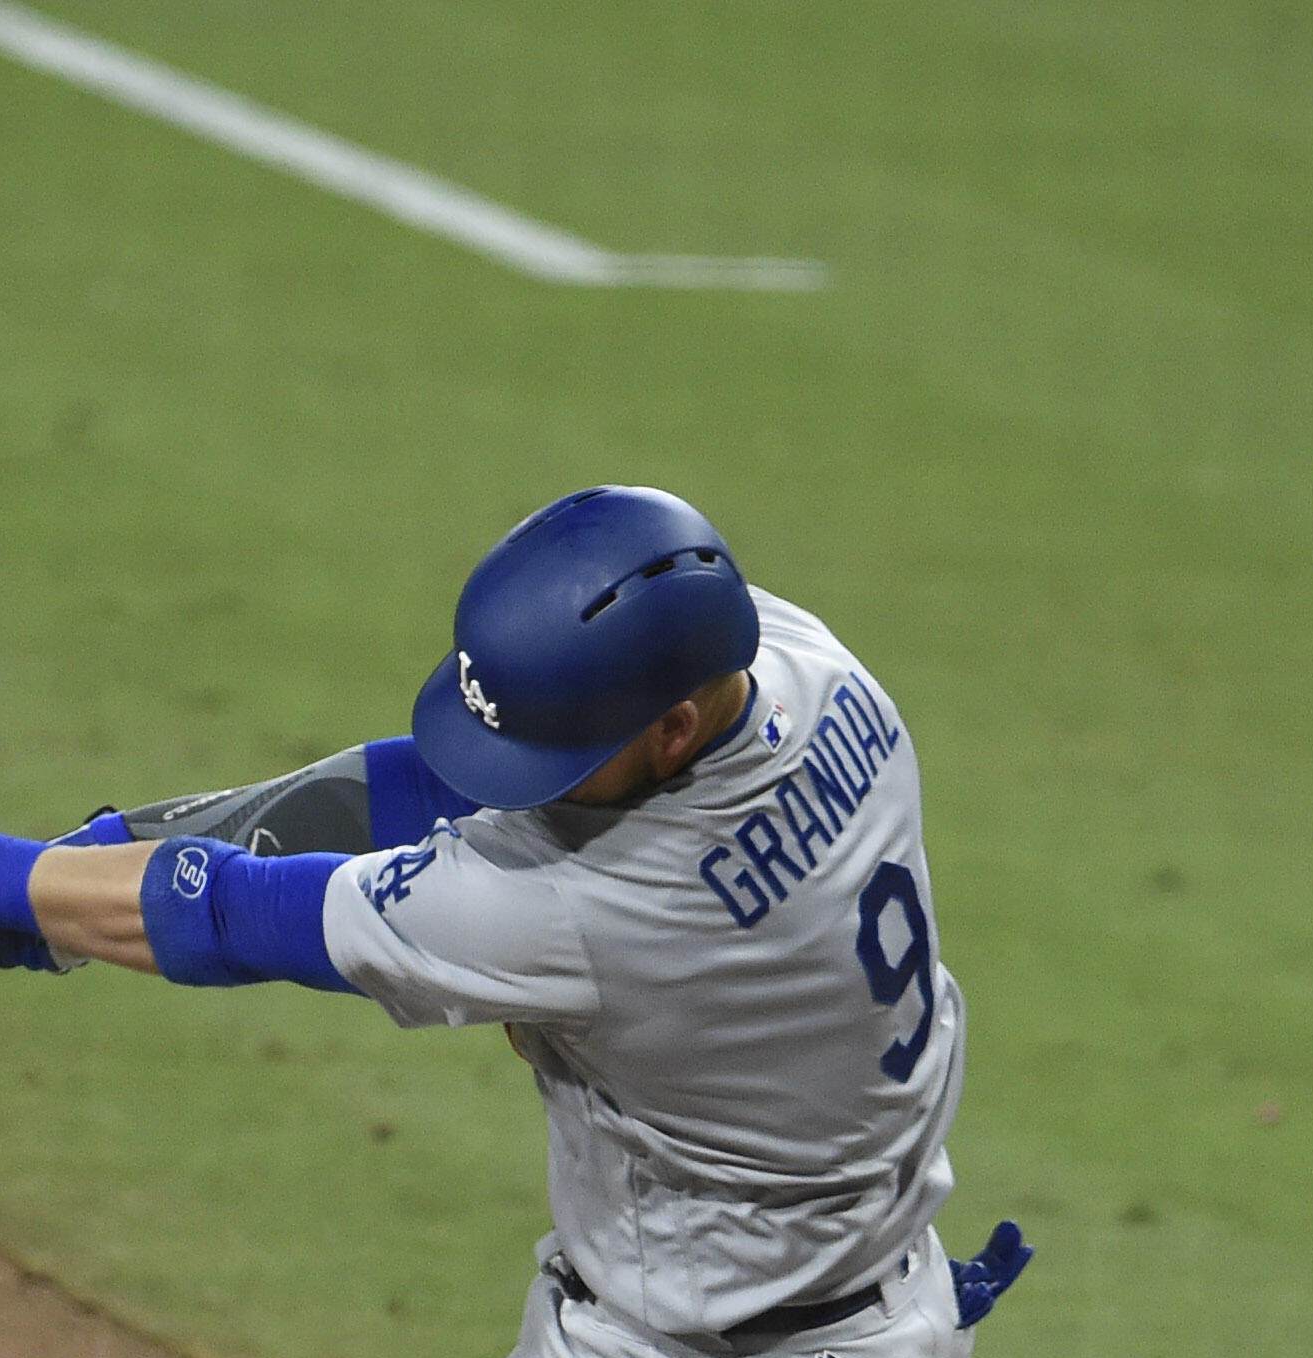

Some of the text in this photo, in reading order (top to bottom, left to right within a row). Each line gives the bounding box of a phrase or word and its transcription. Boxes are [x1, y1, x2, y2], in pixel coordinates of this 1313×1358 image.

[458, 650, 500, 729] LA
[699, 672, 900, 928] GRANDAL
[855, 861, 935, 1084] 9
